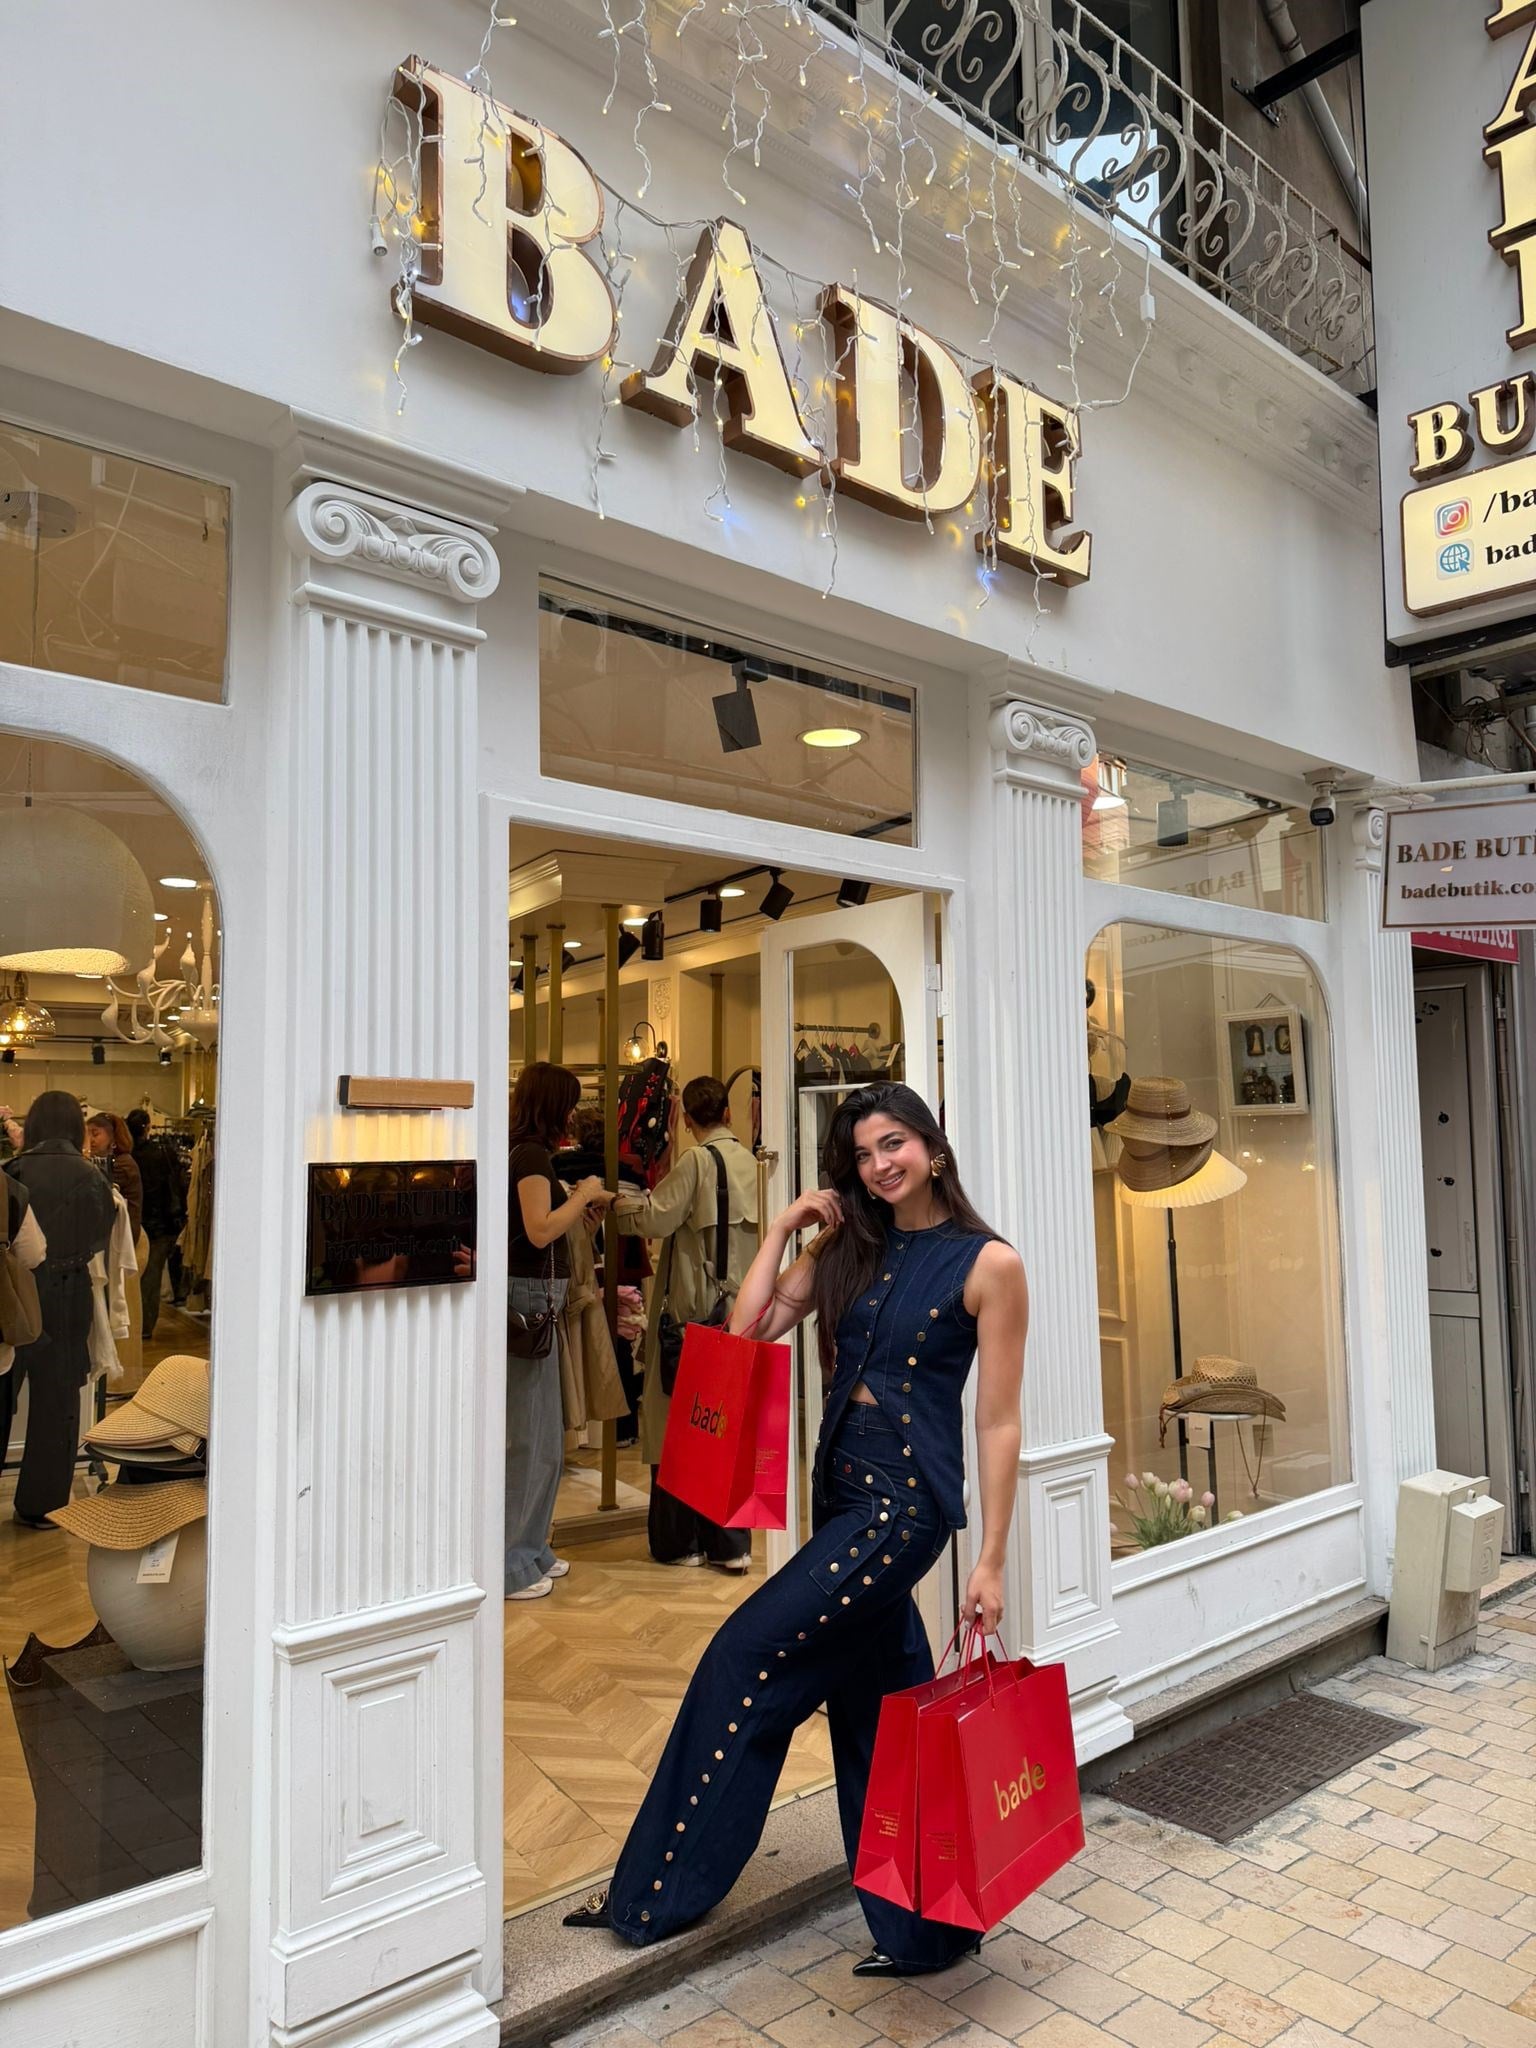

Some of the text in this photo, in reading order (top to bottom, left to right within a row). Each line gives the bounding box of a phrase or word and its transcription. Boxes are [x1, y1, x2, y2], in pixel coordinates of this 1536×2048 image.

[391, 54, 1091, 587] BADE
[1486, 533, 1536, 565] bad
[1396, 839, 1467, 863] BADE
[1401, 880, 1536, 899] badebutik.co
[690, 1391, 728, 1439] bade
[993, 1757, 1046, 1821] bade
